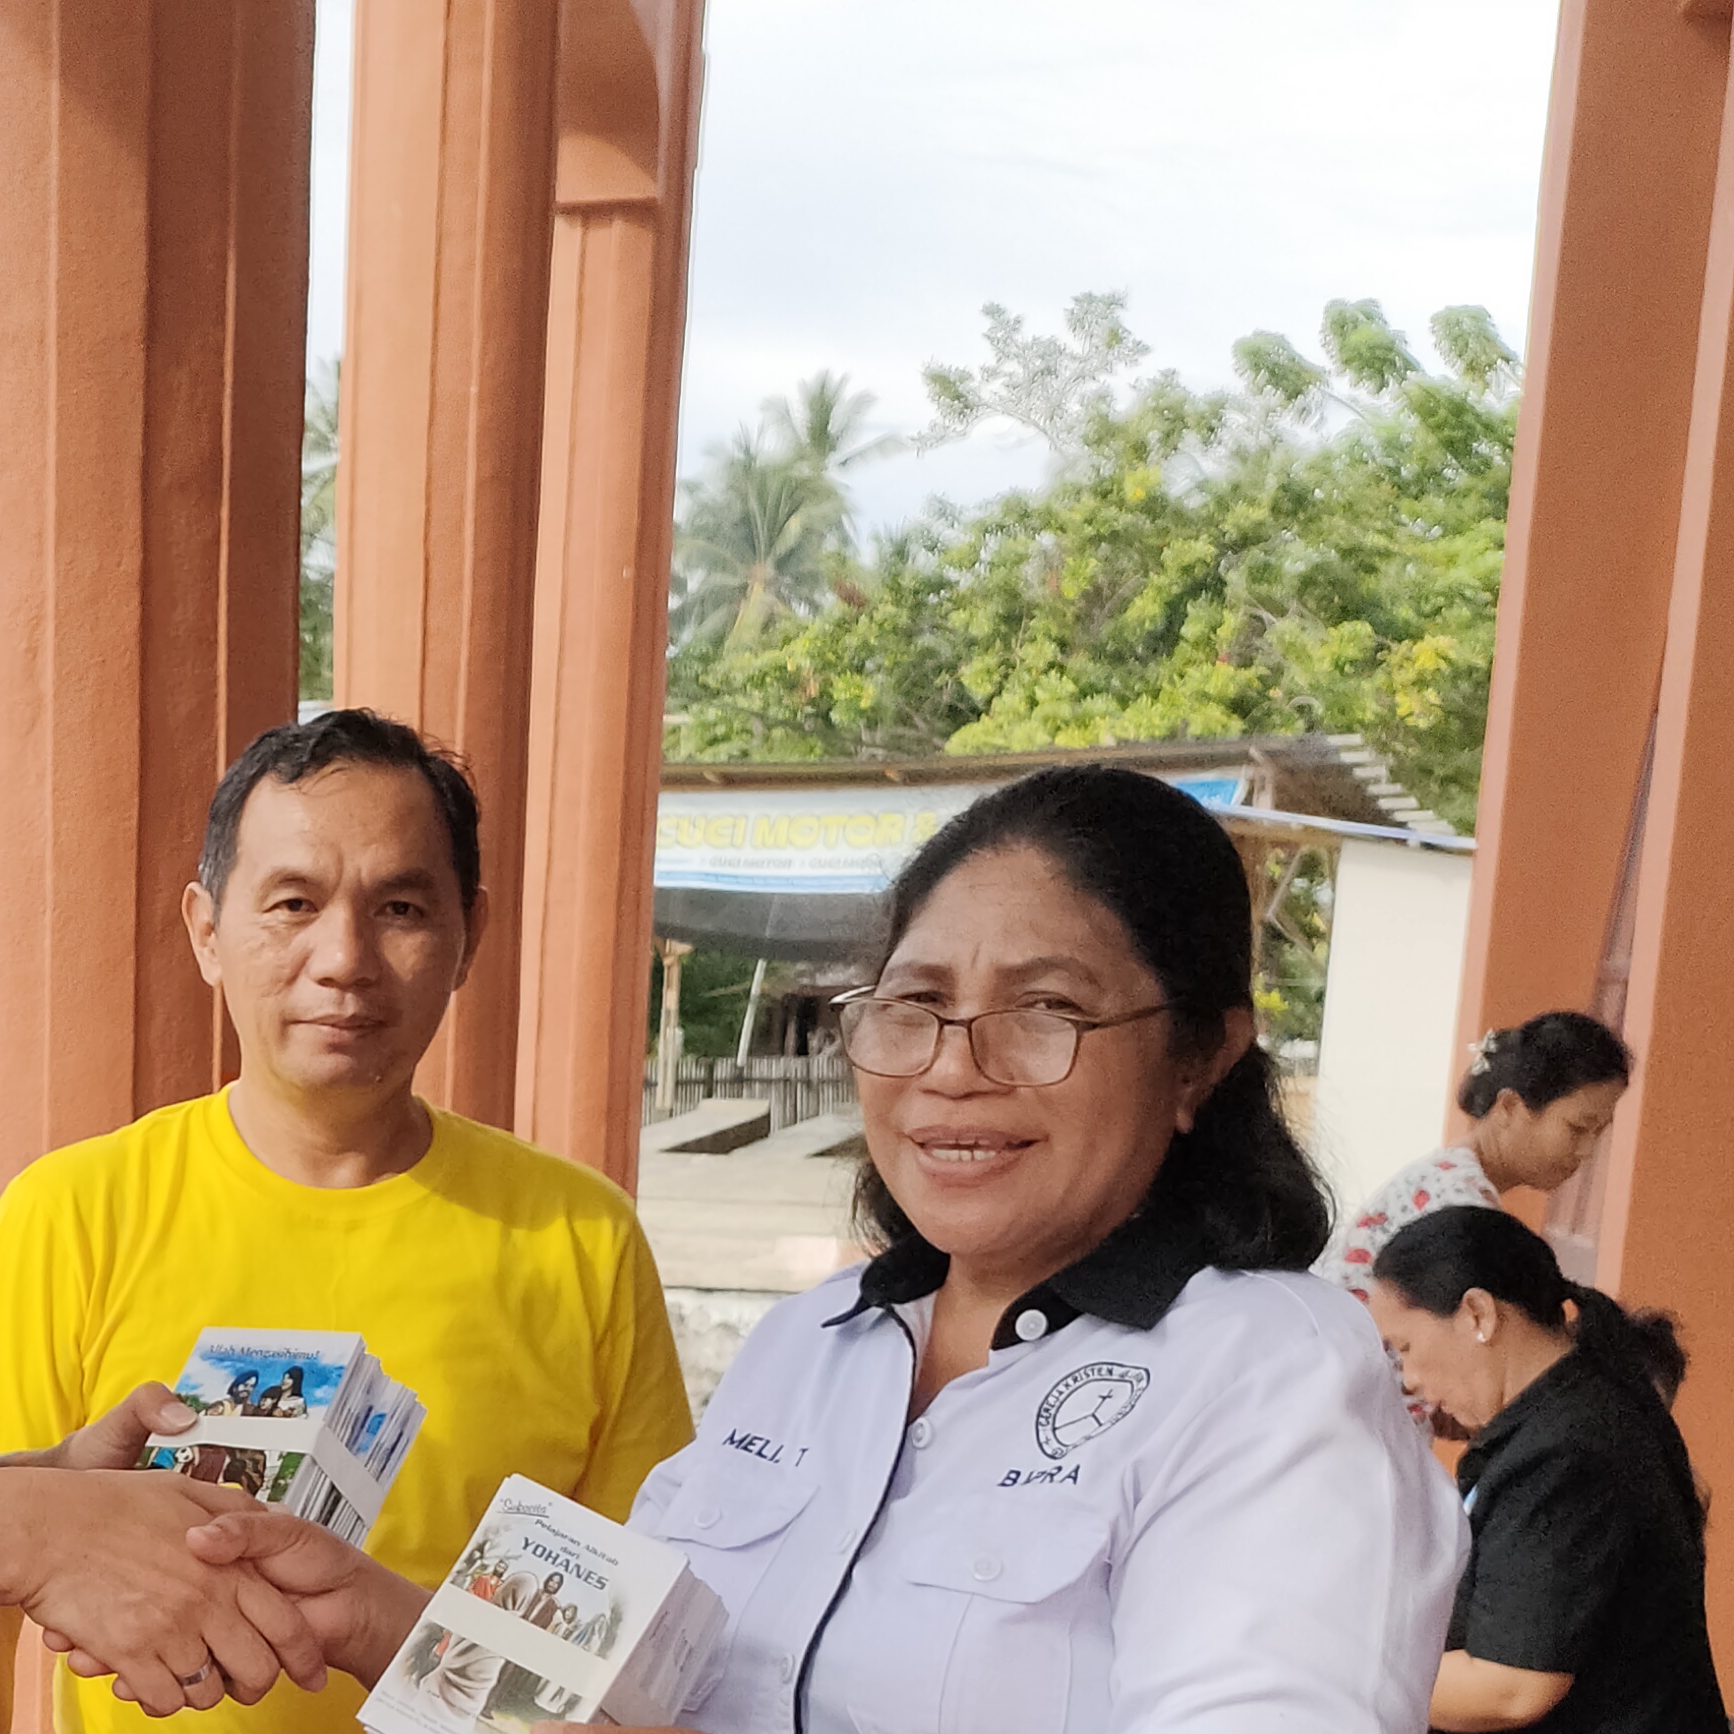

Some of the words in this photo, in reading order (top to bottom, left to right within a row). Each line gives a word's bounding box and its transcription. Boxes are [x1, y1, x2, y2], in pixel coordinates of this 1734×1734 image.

[658, 814, 748, 849] CUCI
[753, 811, 906, 848] MOTOR
[522, 1536, 609, 1590] YOHANES
